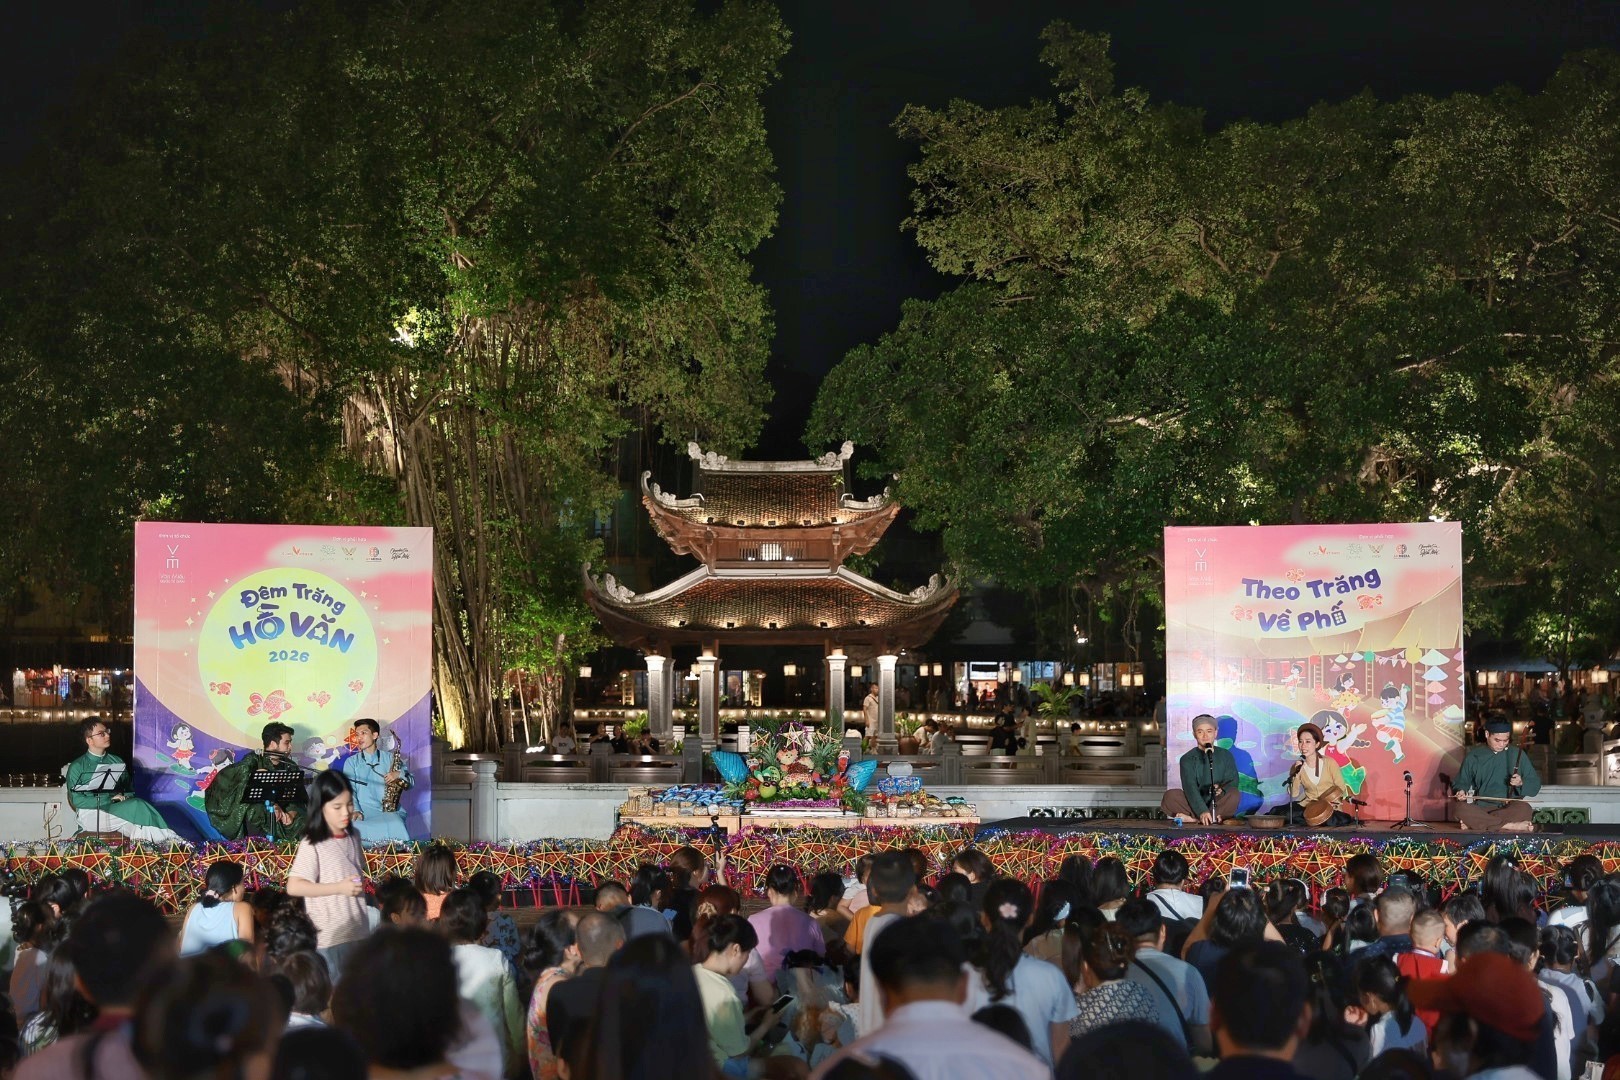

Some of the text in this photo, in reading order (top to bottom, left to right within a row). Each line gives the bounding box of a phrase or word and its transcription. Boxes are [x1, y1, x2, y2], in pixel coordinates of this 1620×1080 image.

[240, 583, 346, 615] Đêm Trăng
[1242, 568, 1382, 600] Theo Trăng
[228, 603, 355, 653] HỒ VĂN
[1257, 600, 1347, 632] Về Phố
[268, 650, 310, 662] 2026
